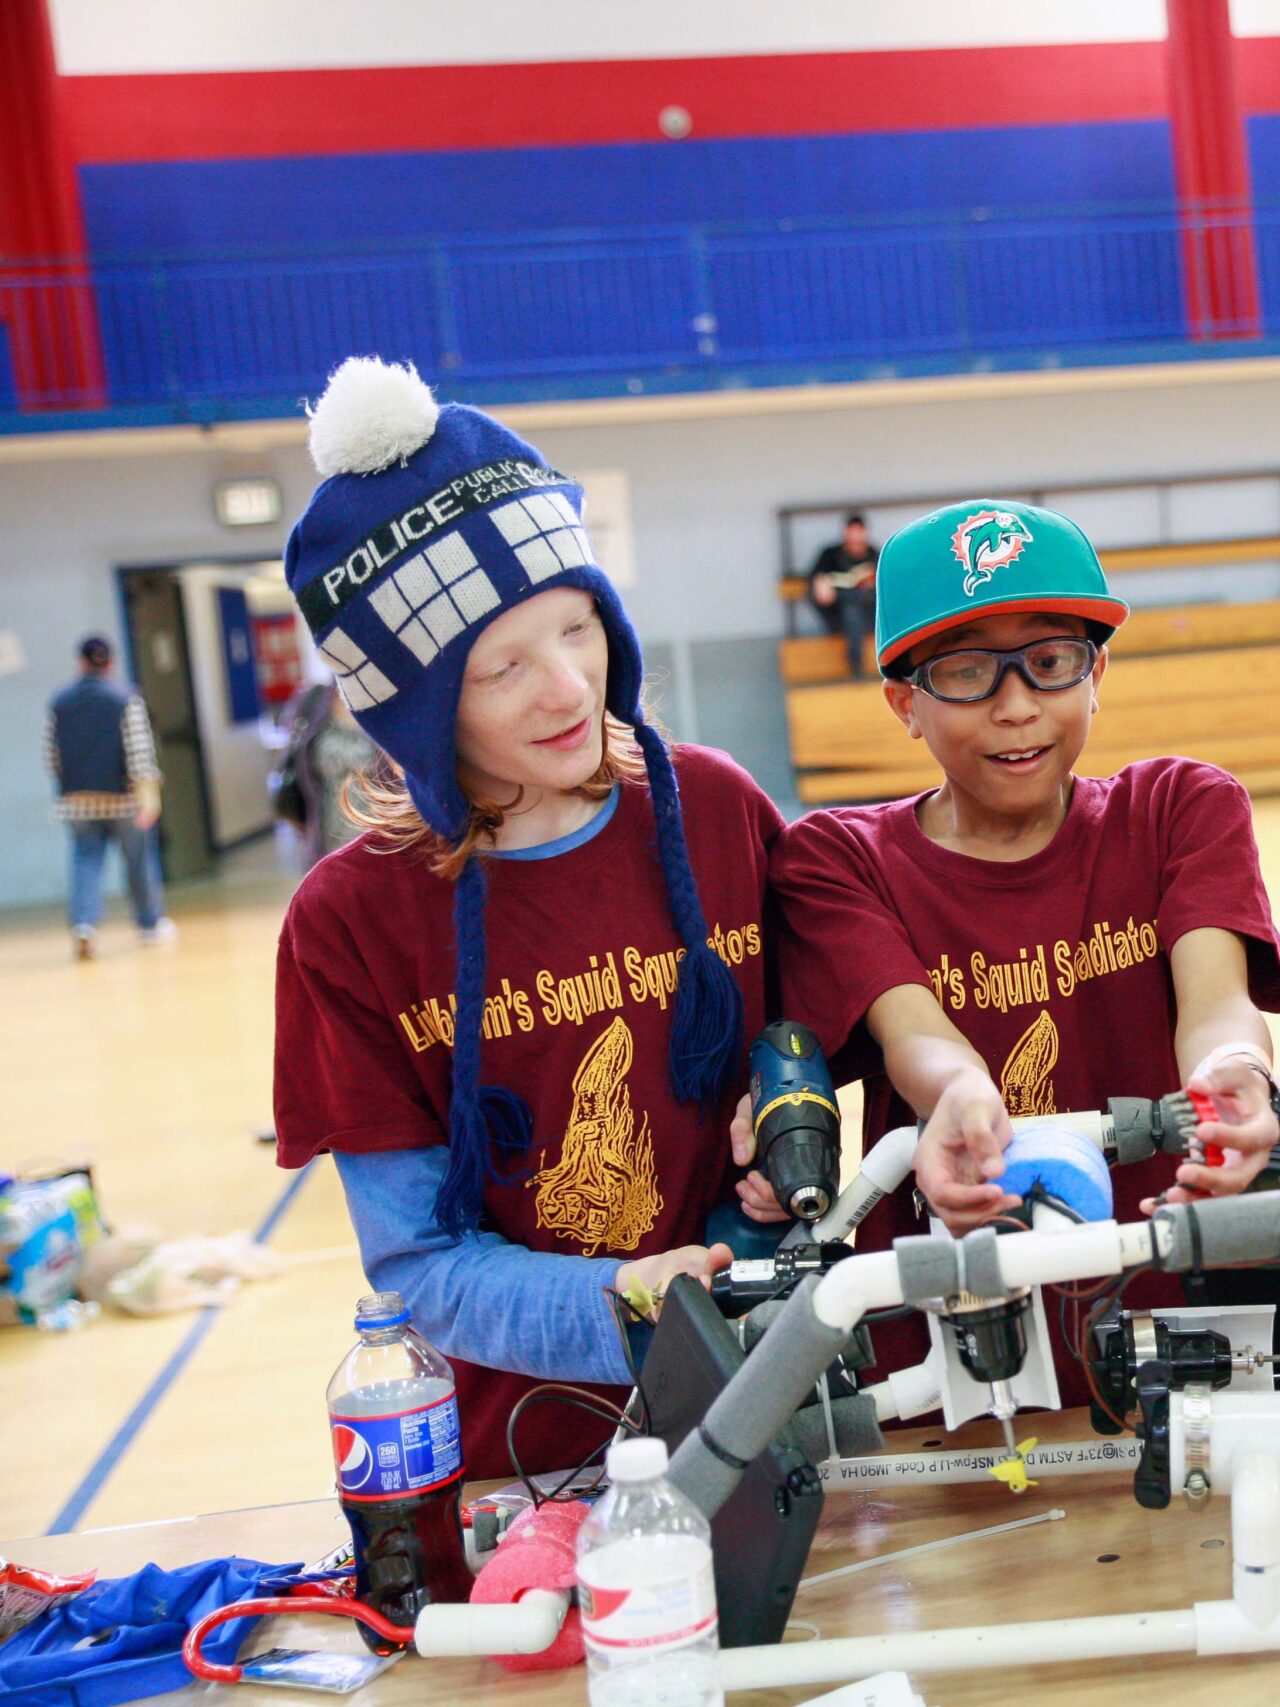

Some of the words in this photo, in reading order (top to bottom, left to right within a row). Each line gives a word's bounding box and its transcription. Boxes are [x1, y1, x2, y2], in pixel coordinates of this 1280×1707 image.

[450, 459, 518, 496] PUBLIC
[473, 477, 529, 503] CALL
[322, 487, 464, 605] POLICE
[536, 951, 624, 1026] Squid
[970, 944, 1050, 1014] Squid
[380, 1445, 397, 1457] 260
[1039, 1449, 1073, 1464] ASTM
